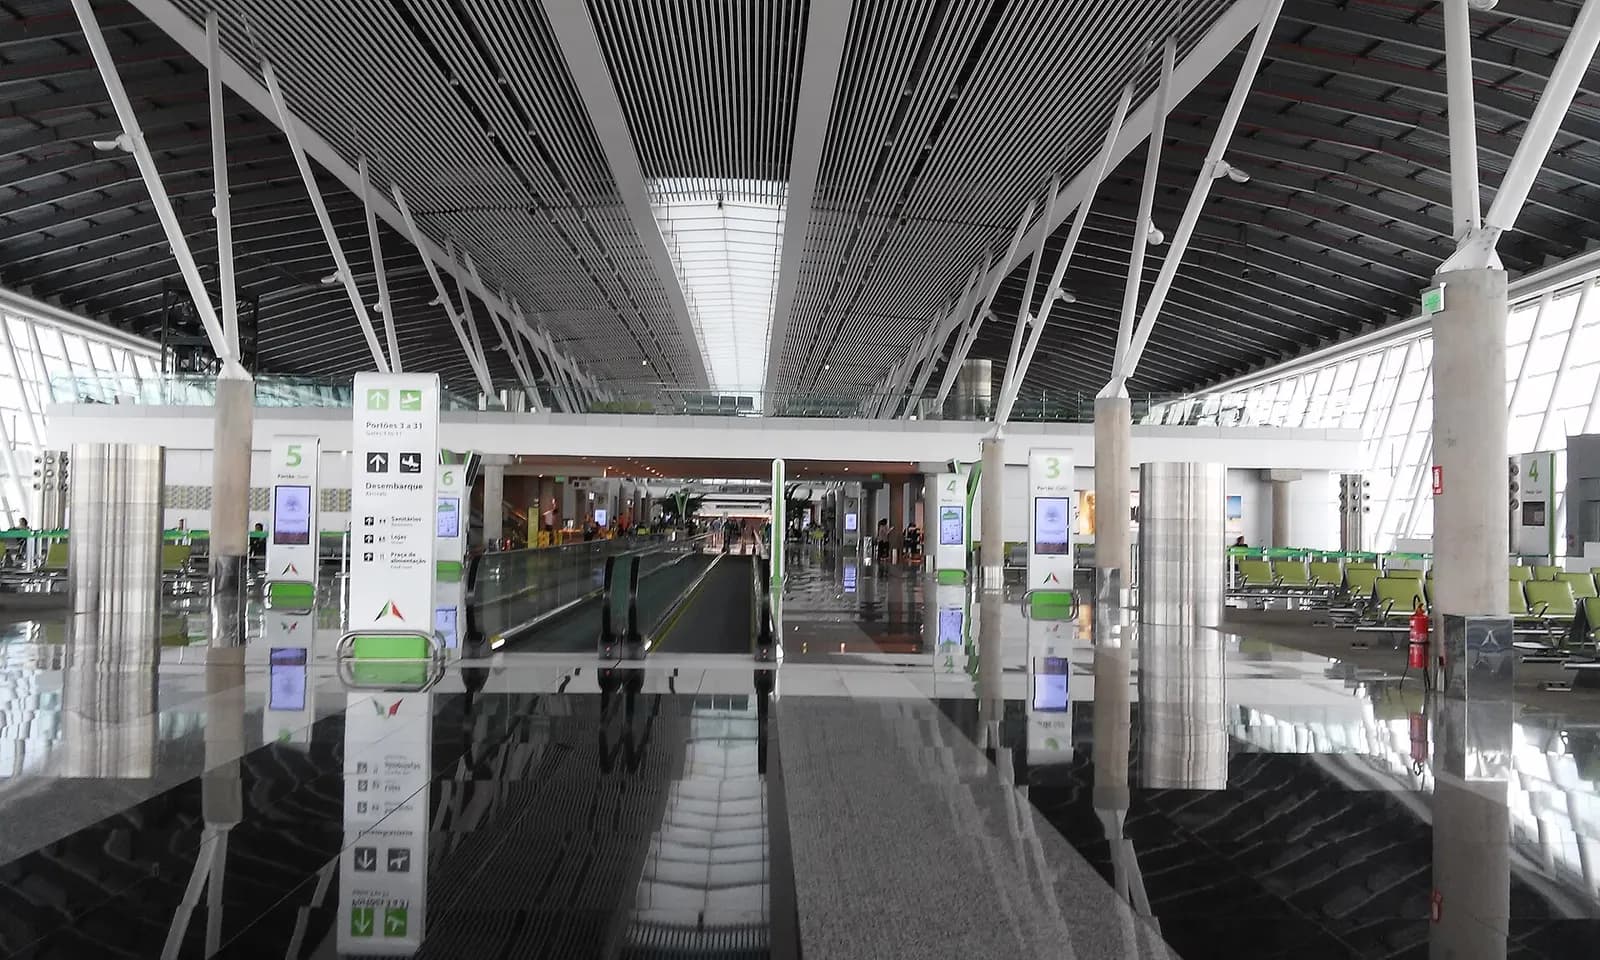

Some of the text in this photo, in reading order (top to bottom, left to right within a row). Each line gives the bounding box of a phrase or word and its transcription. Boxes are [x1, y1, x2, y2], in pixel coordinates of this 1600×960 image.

[366, 421, 397, 429] Portões
[286, 445, 302, 467] 5
[1046, 457, 1060, 479] 3
[1529, 459, 1539, 482] 4
[442, 471, 454, 486] 6
[365, 482, 423, 492] Desembarque
[946, 480, 957, 495] 4
[390, 533, 407, 541] Lojas
